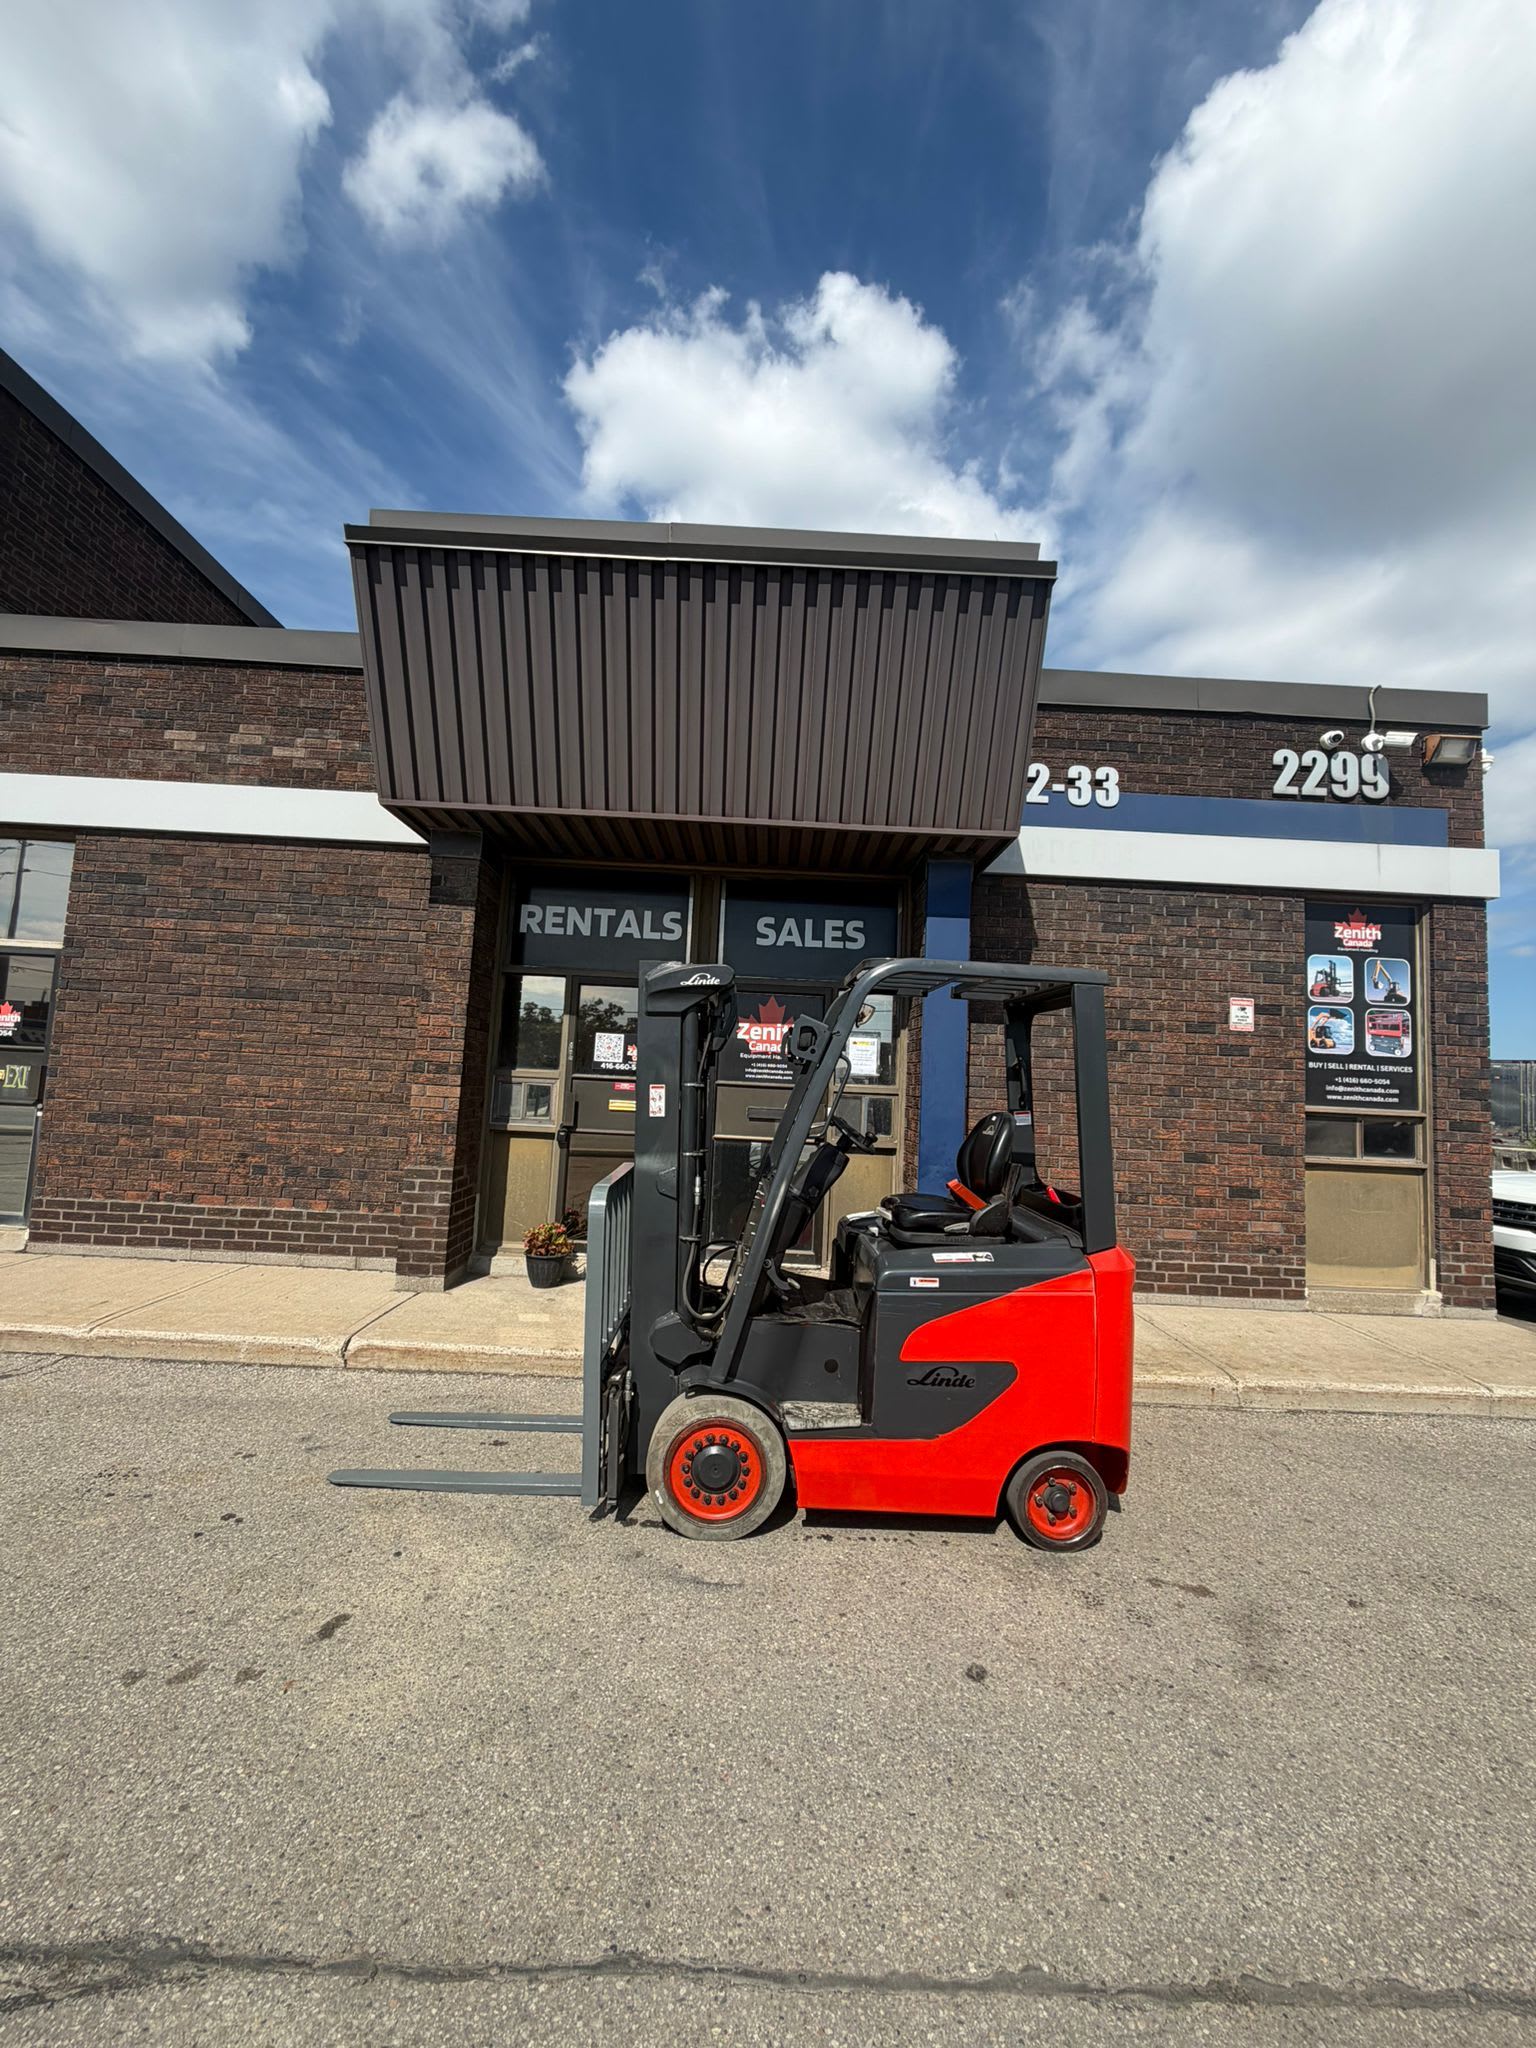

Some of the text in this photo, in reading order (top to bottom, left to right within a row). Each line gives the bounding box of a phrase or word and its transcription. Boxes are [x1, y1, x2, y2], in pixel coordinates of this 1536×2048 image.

[1272, 749, 1390, 799] 2299
[1026, 763, 1120, 807] 2-33
[519, 904, 683, 941] RENTALS
[756, 916, 866, 950] SALES
[1334, 926, 1382, 940] Zenith
[1343, 939, 1373, 947] Canada
[680, 972, 721, 986] Linde
[736, 1022, 795, 1041] Zenit
[1308, 1061, 1323, 1069] BUY
[1349, 1064, 1376, 1072] RENTAL
[1325, 1084, 1399, 1094] info@zenithcanada.com
[1326, 1094, 1399, 1103] www.zenithcanada.com
[906, 1366, 976, 1388] Linde
